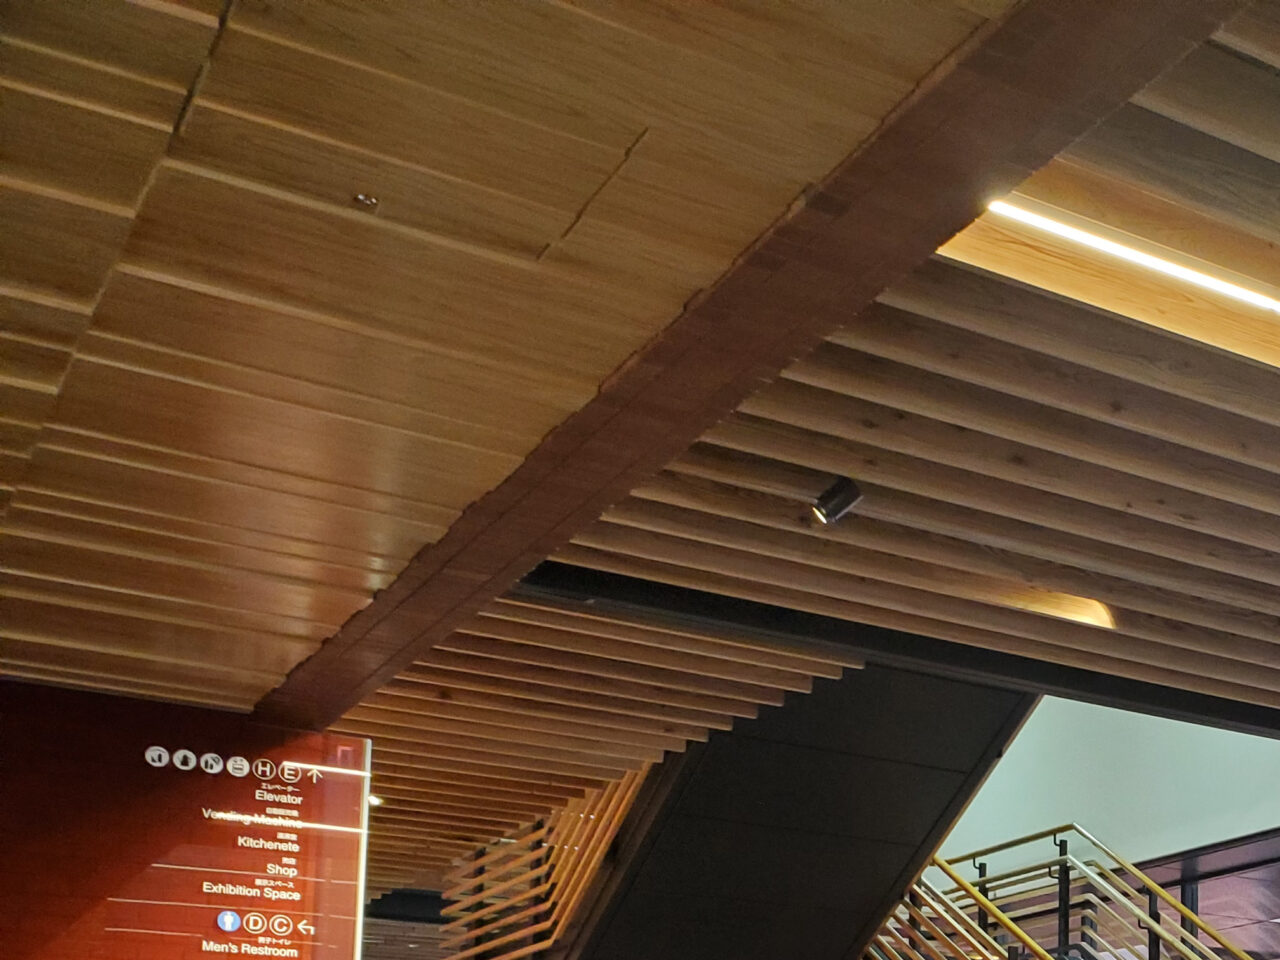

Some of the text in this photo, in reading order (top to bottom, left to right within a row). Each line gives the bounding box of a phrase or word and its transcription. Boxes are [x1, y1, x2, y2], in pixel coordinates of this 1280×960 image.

[255, 789, 303, 805] Elevator
[266, 863, 298, 878] Shop
[202, 882, 301, 901] Exhibition Space
[202, 940, 298, 958] Men's Restroom
